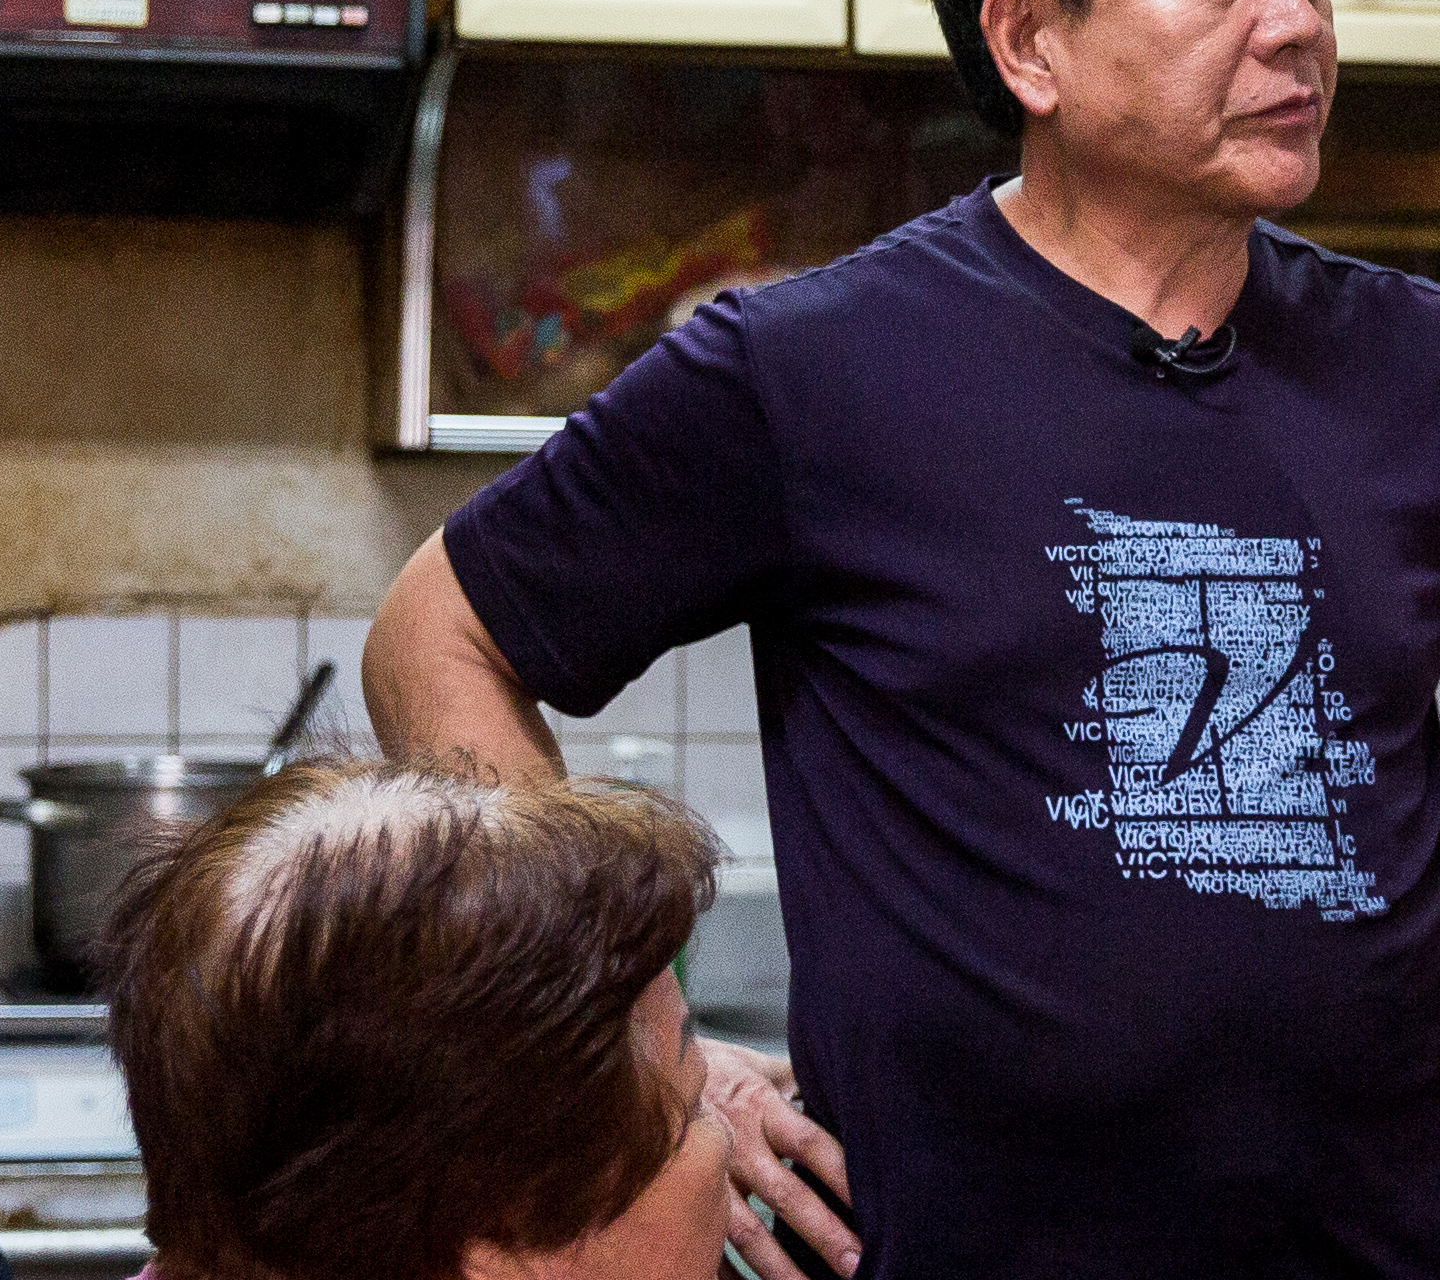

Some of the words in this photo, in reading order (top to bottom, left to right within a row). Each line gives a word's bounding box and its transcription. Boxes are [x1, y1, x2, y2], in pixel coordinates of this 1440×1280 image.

[1320, 691, 1344, 706] TO
[1323, 706, 1352, 721] VIC
[1063, 721, 1102, 741] VIC
